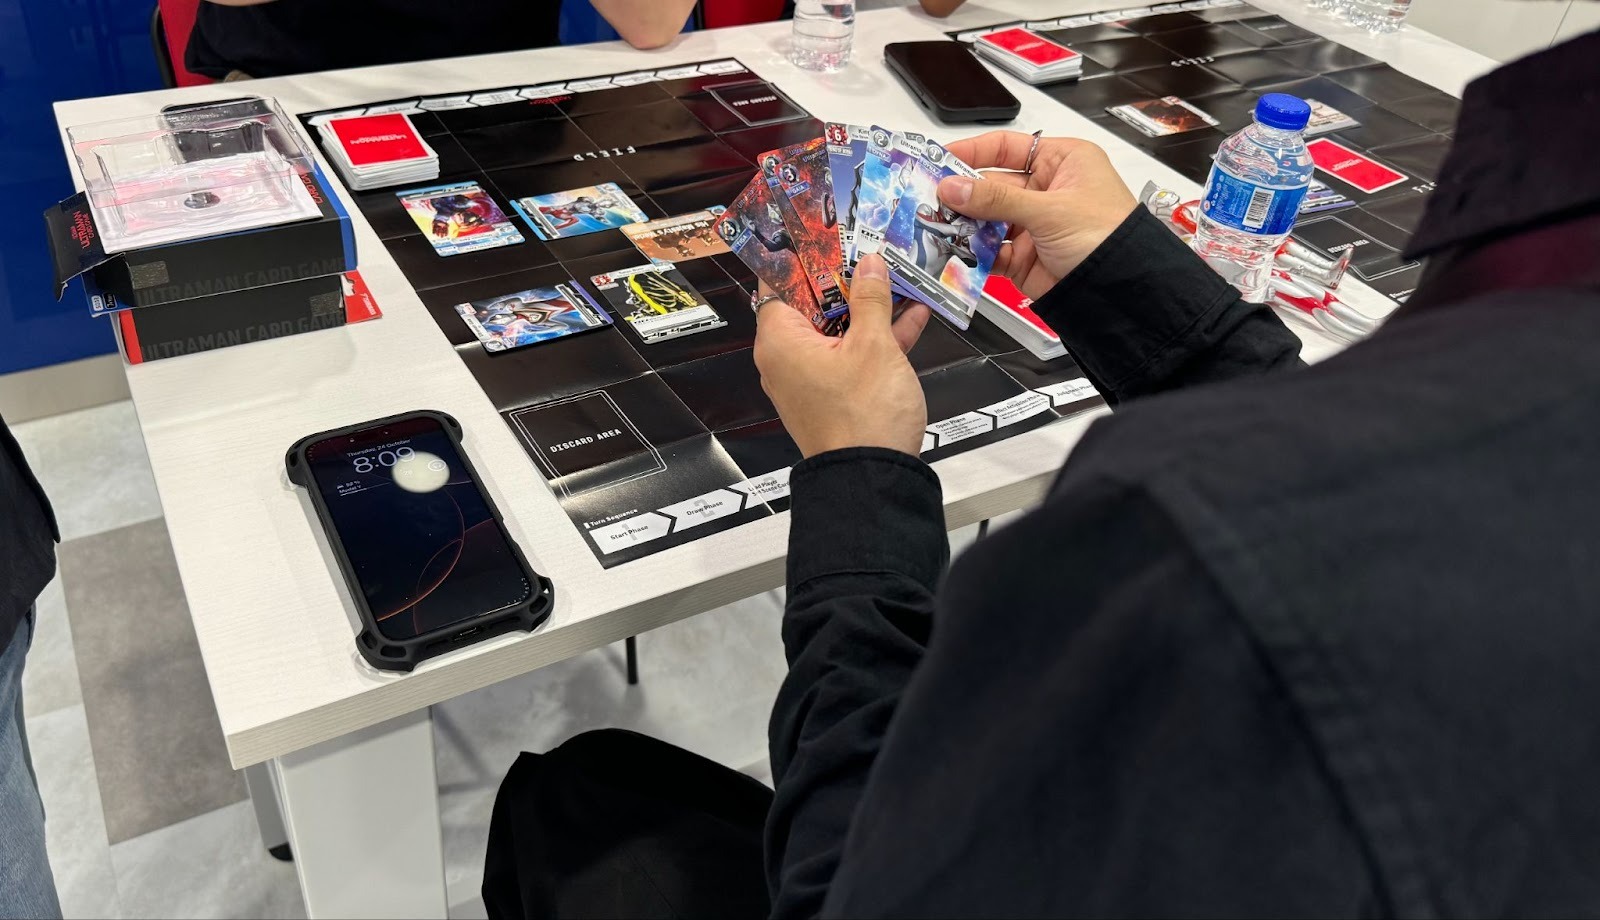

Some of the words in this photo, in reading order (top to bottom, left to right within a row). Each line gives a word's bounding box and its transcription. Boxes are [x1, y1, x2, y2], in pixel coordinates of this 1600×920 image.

[834, 129, 842, 141] 6
[877, 132, 884, 146] 2
[573, 145, 637, 162] FIELD
[930, 148, 938, 160] 1
[784, 168, 794, 181] 3
[792, 184, 805, 194] GAIA
[723, 220, 736, 236] 3
[736, 234, 748, 247] TIGA
[244, 265, 296, 285] CARD
[246, 319, 293, 341] CARD
[386, 439, 411, 448] October
[549, 436, 594, 453] DISCARD
[596, 428, 622, 440] AREA
[353, 447, 416, 473] 8:09
[686, 507, 704, 516] Draw
[703, 501, 724, 511] Phase
[589, 518, 606, 528] Turn
[605, 508, 638, 522] Sequence
[610, 531, 629, 541] Start
[627, 525, 649, 536] Phase
